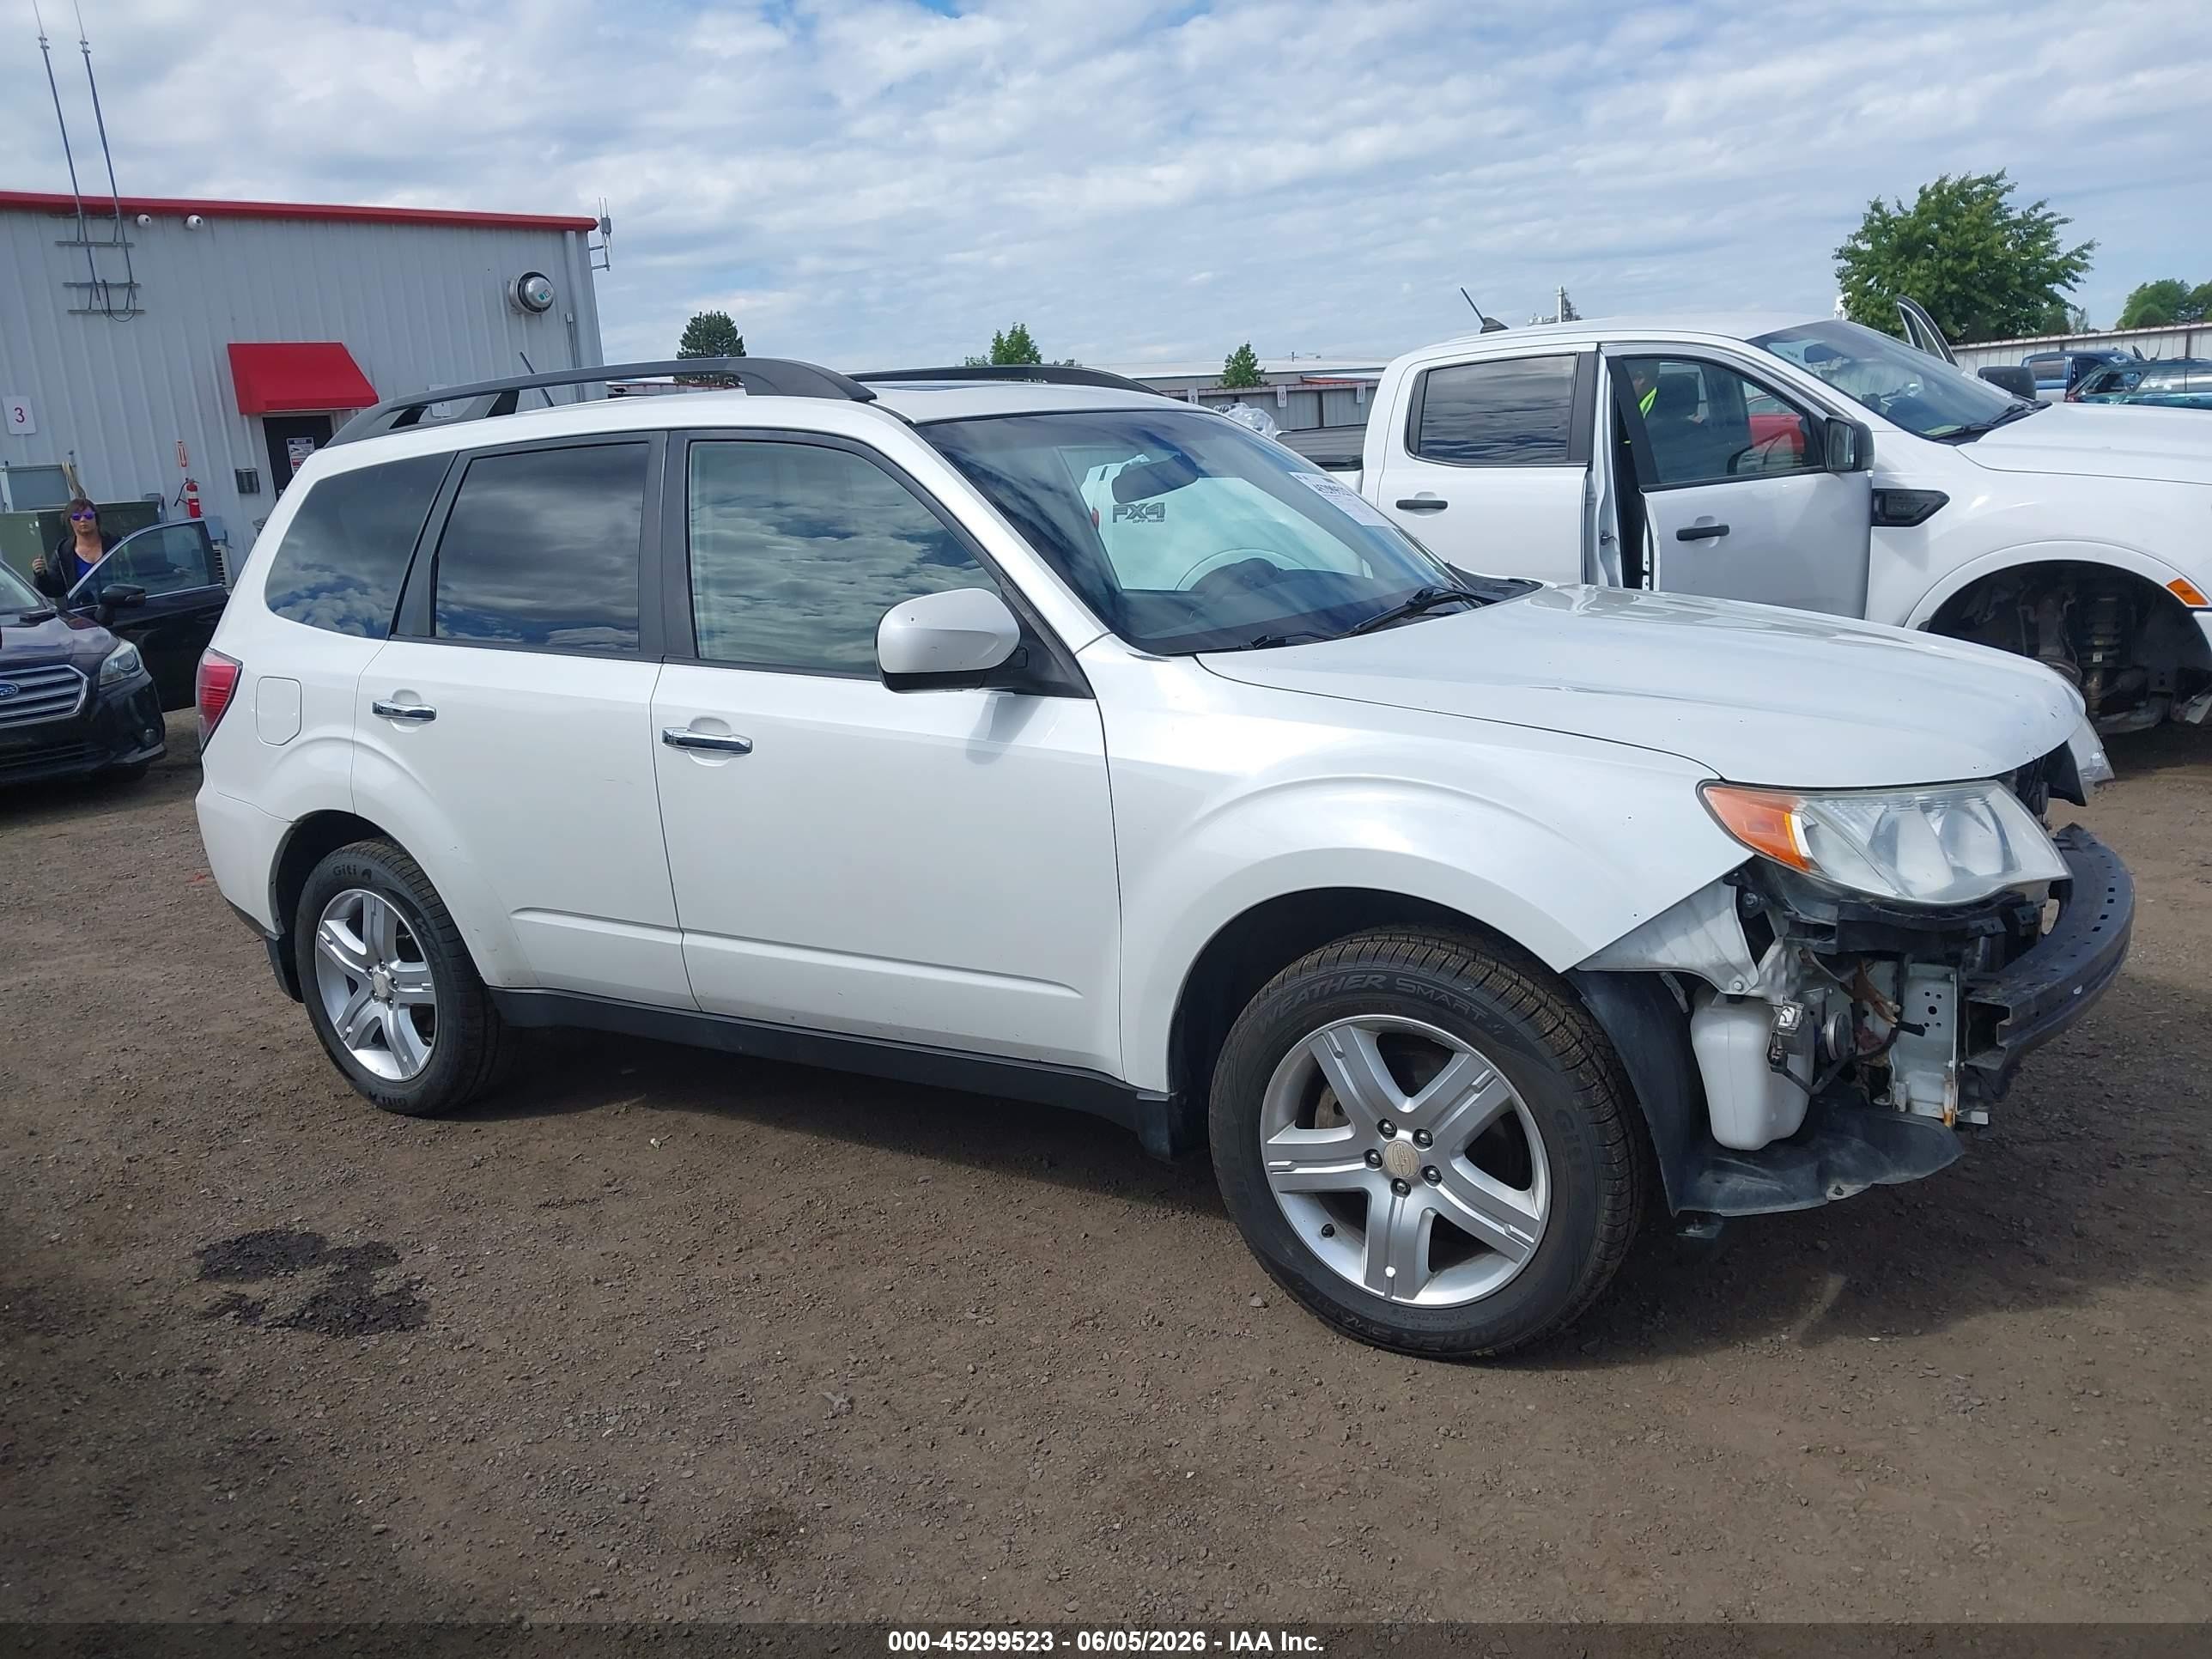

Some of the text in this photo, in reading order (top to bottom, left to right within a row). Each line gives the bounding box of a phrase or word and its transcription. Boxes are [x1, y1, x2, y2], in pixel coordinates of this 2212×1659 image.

[1279, 391, 1285, 401] 10
[14, 406, 25, 423] 3
[1113, 501, 1165, 524] FX4
[1264, 974, 1489, 1028] WEATHER SMART
